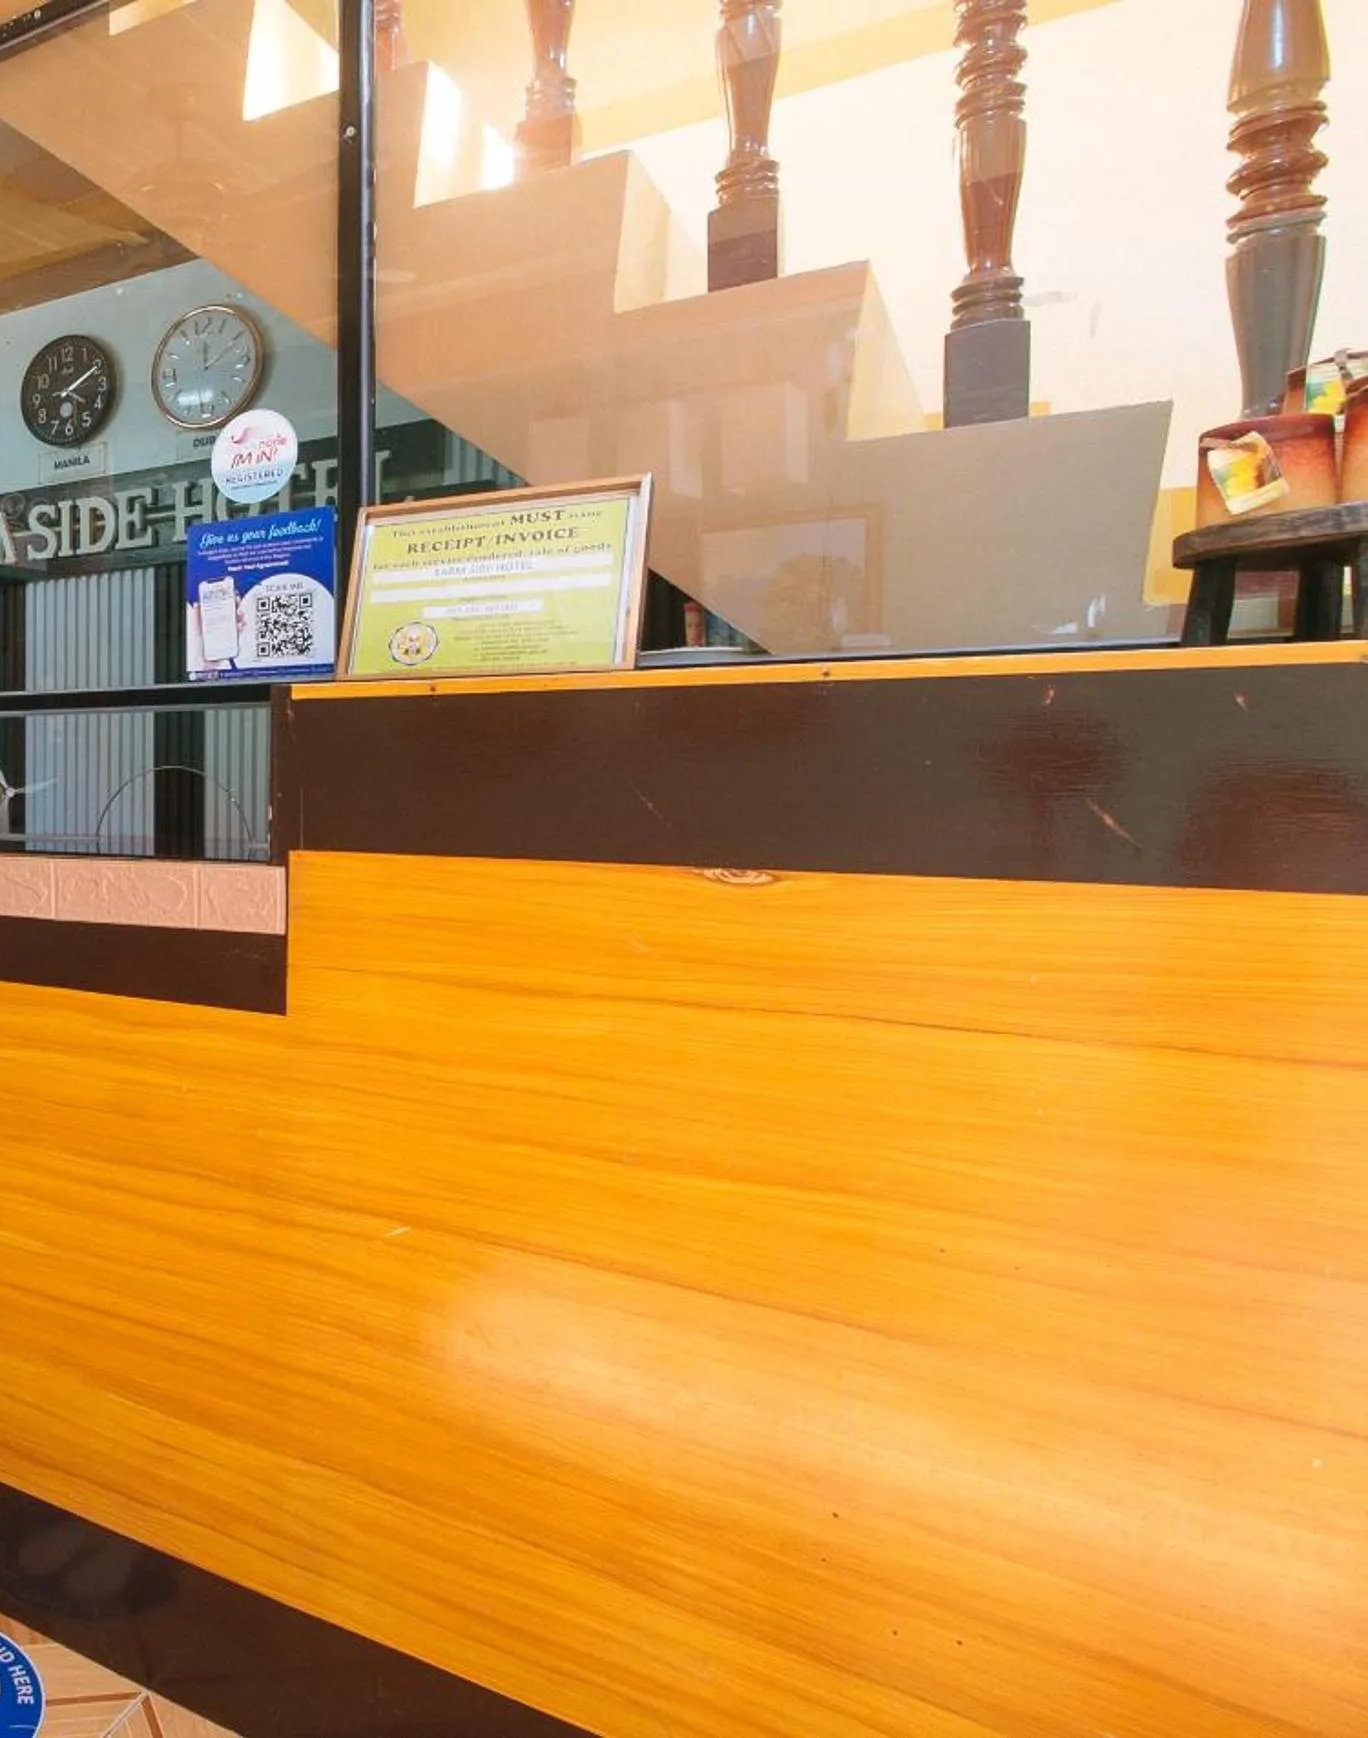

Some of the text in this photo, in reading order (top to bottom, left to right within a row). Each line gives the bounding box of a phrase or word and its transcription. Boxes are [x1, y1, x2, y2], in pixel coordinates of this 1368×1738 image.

[60, 346, 73, 362] 12
[81, 347, 87, 361] 1
[47, 356, 58, 373] 11
[92, 359, 103, 374] 2
[33, 374, 50, 389] 10
[97, 376, 107, 391] 3
[32, 393, 41, 409] 9
[93, 395, 103, 409] 4
[38, 408, 47, 424] 8
[81, 412, 92, 427] 5
[50, 420, 59, 435] 7
[64, 420, 74, 436] 6
[193, 436, 216, 448] DUB
[54, 456, 90, 470] MANILA
[225, 468, 284, 485] REGISTERED
[28, 487, 153, 560] SIDE
[172, 450, 391, 542] HTE
[510, 510, 566, 526] MUST
[7, 1663, 35, 1705] HERE
